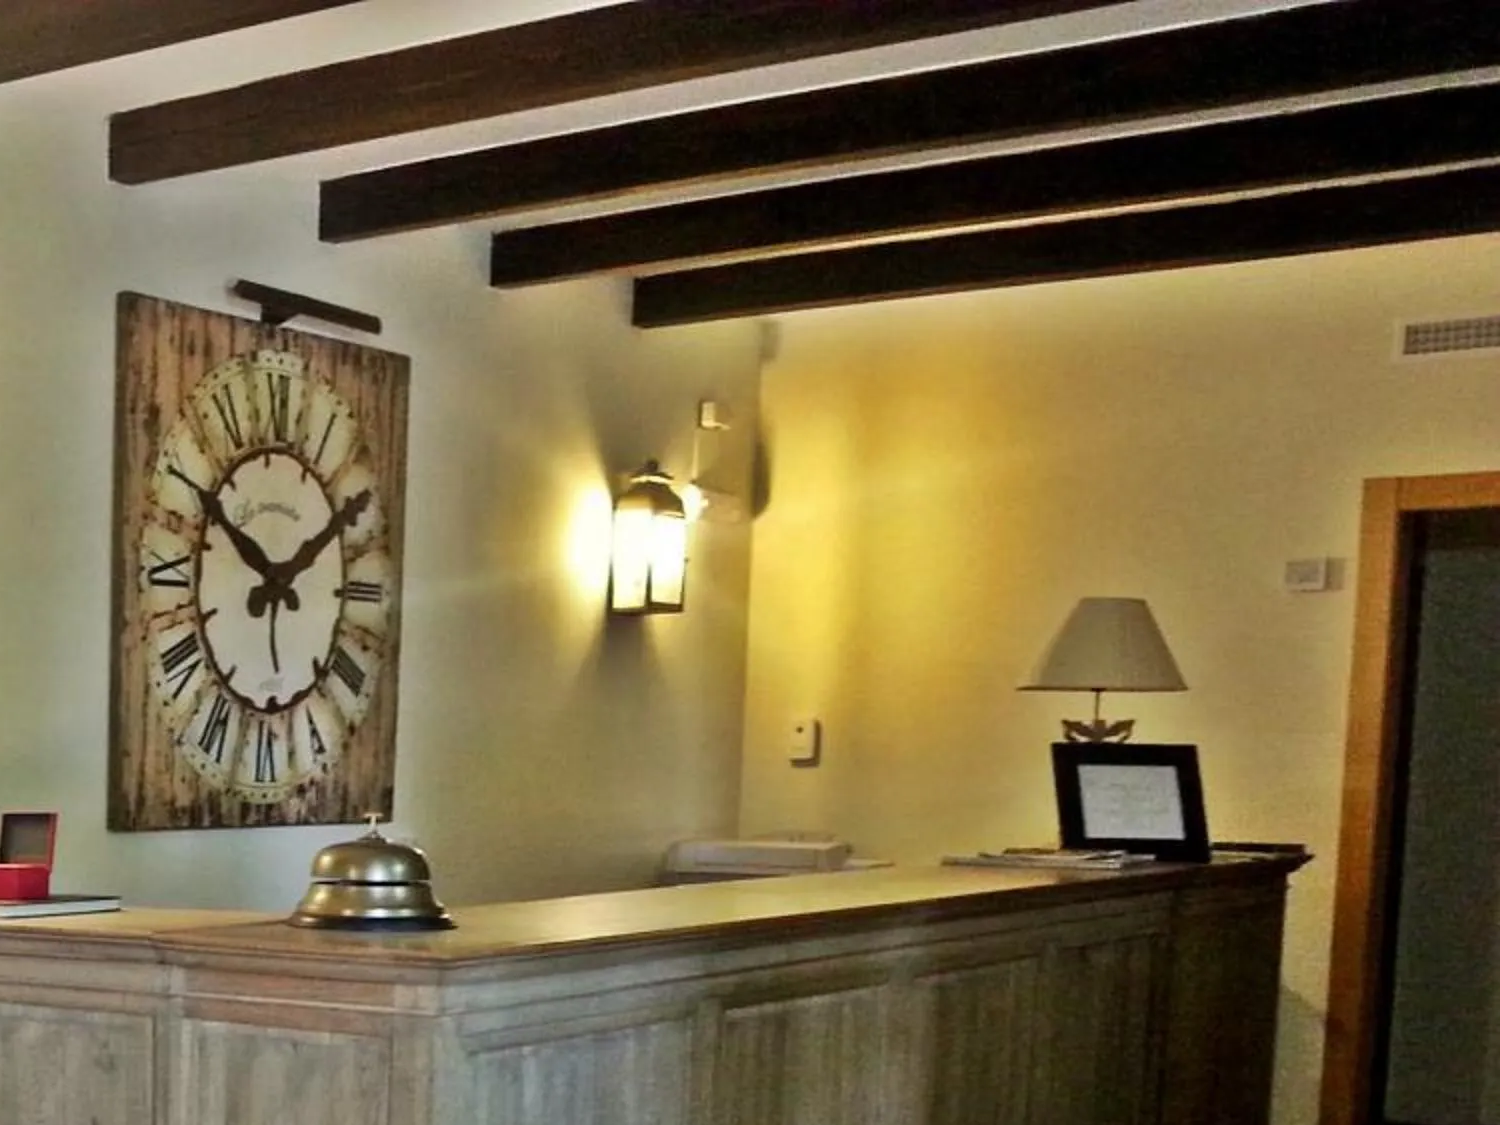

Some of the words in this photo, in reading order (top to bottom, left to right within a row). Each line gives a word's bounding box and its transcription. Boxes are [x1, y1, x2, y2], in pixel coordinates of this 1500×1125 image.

[147, 549, 191, 588] IX
[346, 580, 382, 603] III
[160, 631, 203, 700] VIII
